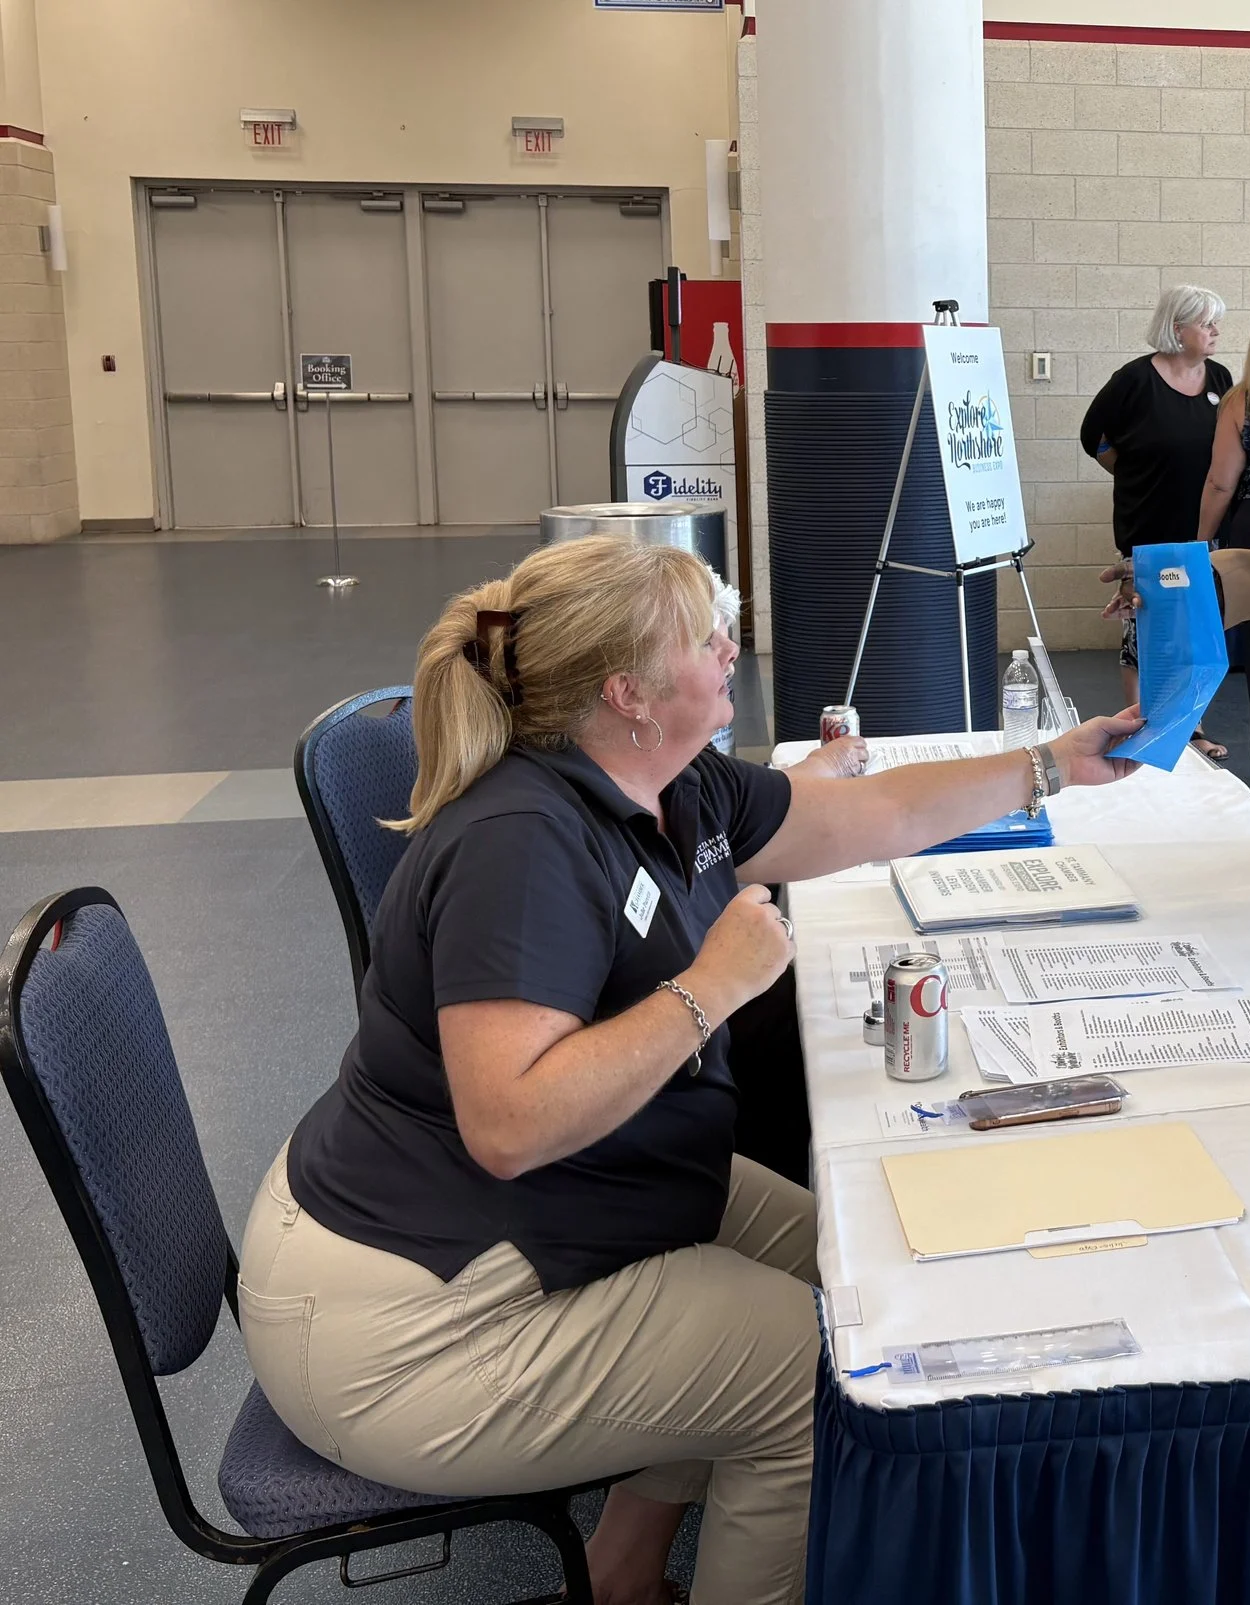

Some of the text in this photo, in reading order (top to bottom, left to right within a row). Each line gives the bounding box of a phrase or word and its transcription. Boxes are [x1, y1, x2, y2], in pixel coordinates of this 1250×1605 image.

[253, 123, 282, 145] EXIT
[525, 131, 552, 152] EXIT
[950, 352, 979, 364] Welcome
[307, 363, 346, 376] Booking
[312, 373, 342, 382] Office
[948, 389, 986, 435] Explore
[947, 431, 1004, 470] Northshore
[648, 476, 722, 499] Fidelity
[965, 498, 1005, 512] We are happy
[969, 512, 1007, 533] you are here!
[954, 867, 980, 894] PRESIDENT
[968, 868, 994, 893] CHAMBER
[1022, 859, 1062, 893] EXPLORE
[1053, 860, 1079, 882] CHAMBER
[1068, 862, 1096, 886] TAMMANY
[927, 870, 953, 896] INVESTORS
[944, 874, 964, 890] LEVEL
[903, 1021, 910, 1035] ME
[1053, 1011, 1062, 1026] Booths
[1056, 1029, 1067, 1050] Exhibitors
